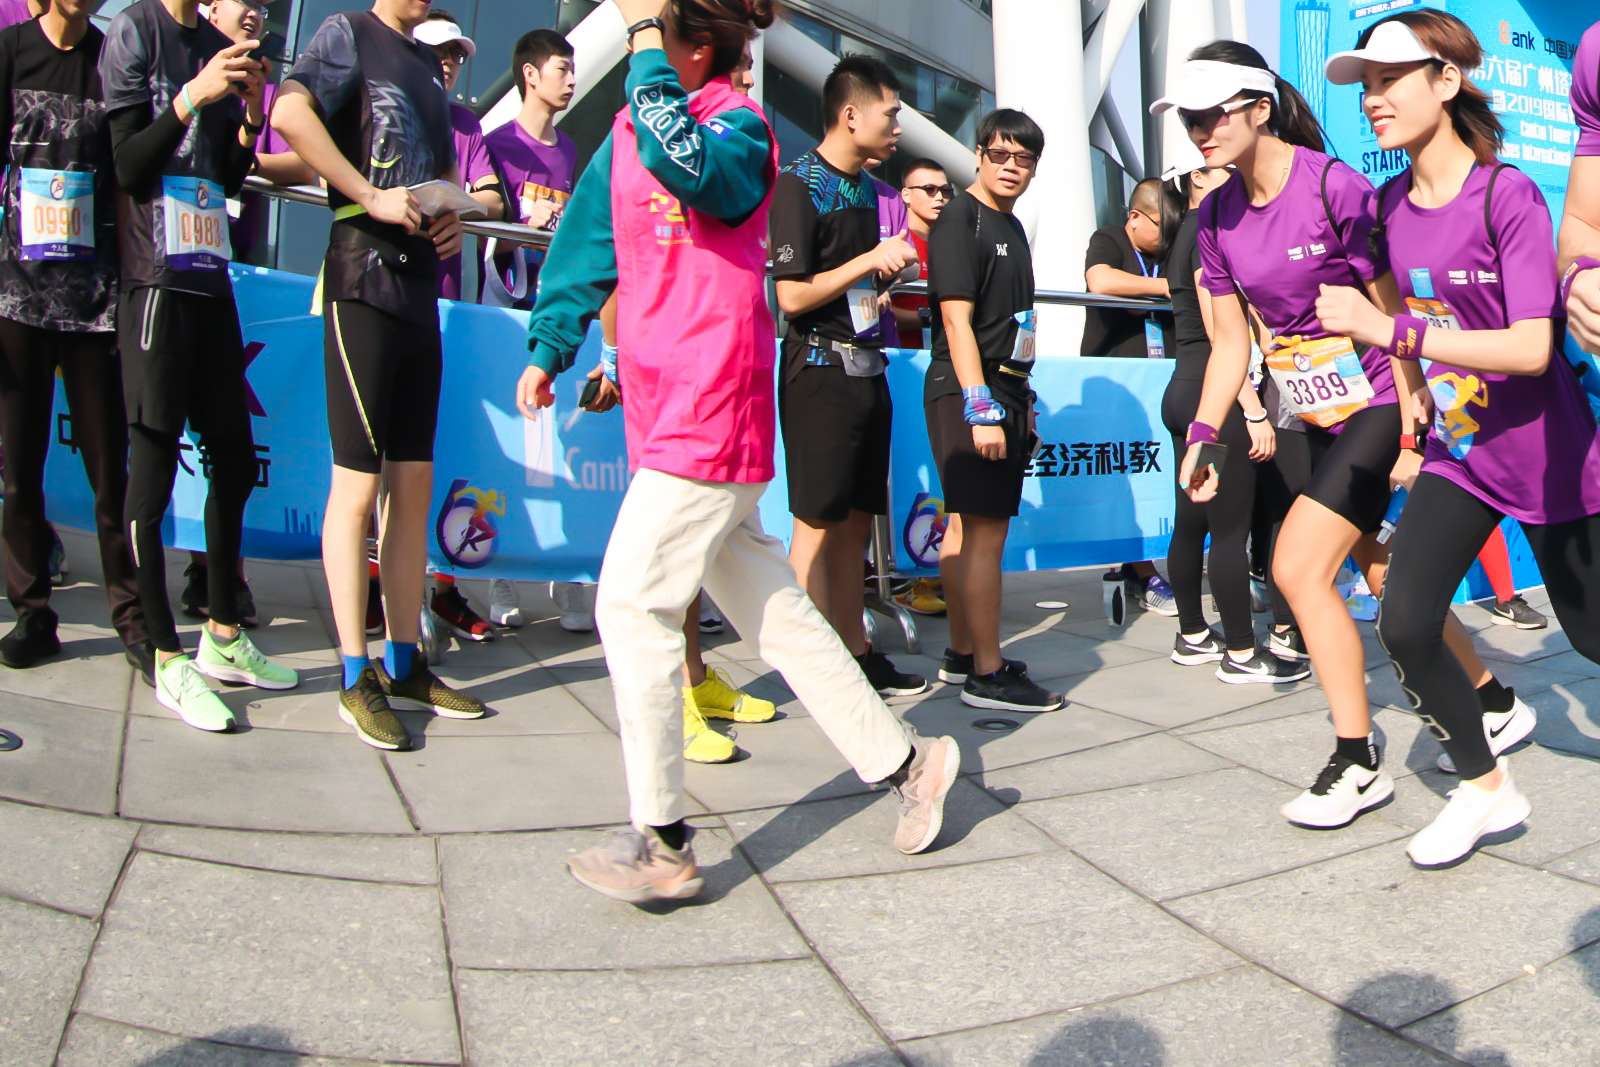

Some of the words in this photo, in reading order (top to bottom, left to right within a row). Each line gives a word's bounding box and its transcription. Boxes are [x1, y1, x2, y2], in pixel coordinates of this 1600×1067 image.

[34, 205, 82, 236] 0990
[181, 213, 221, 248] 0983
[1286, 372, 1349, 406] 3389
[564, 446, 634, 491] Cant
[1023, 441, 1162, 478] 经济科教
